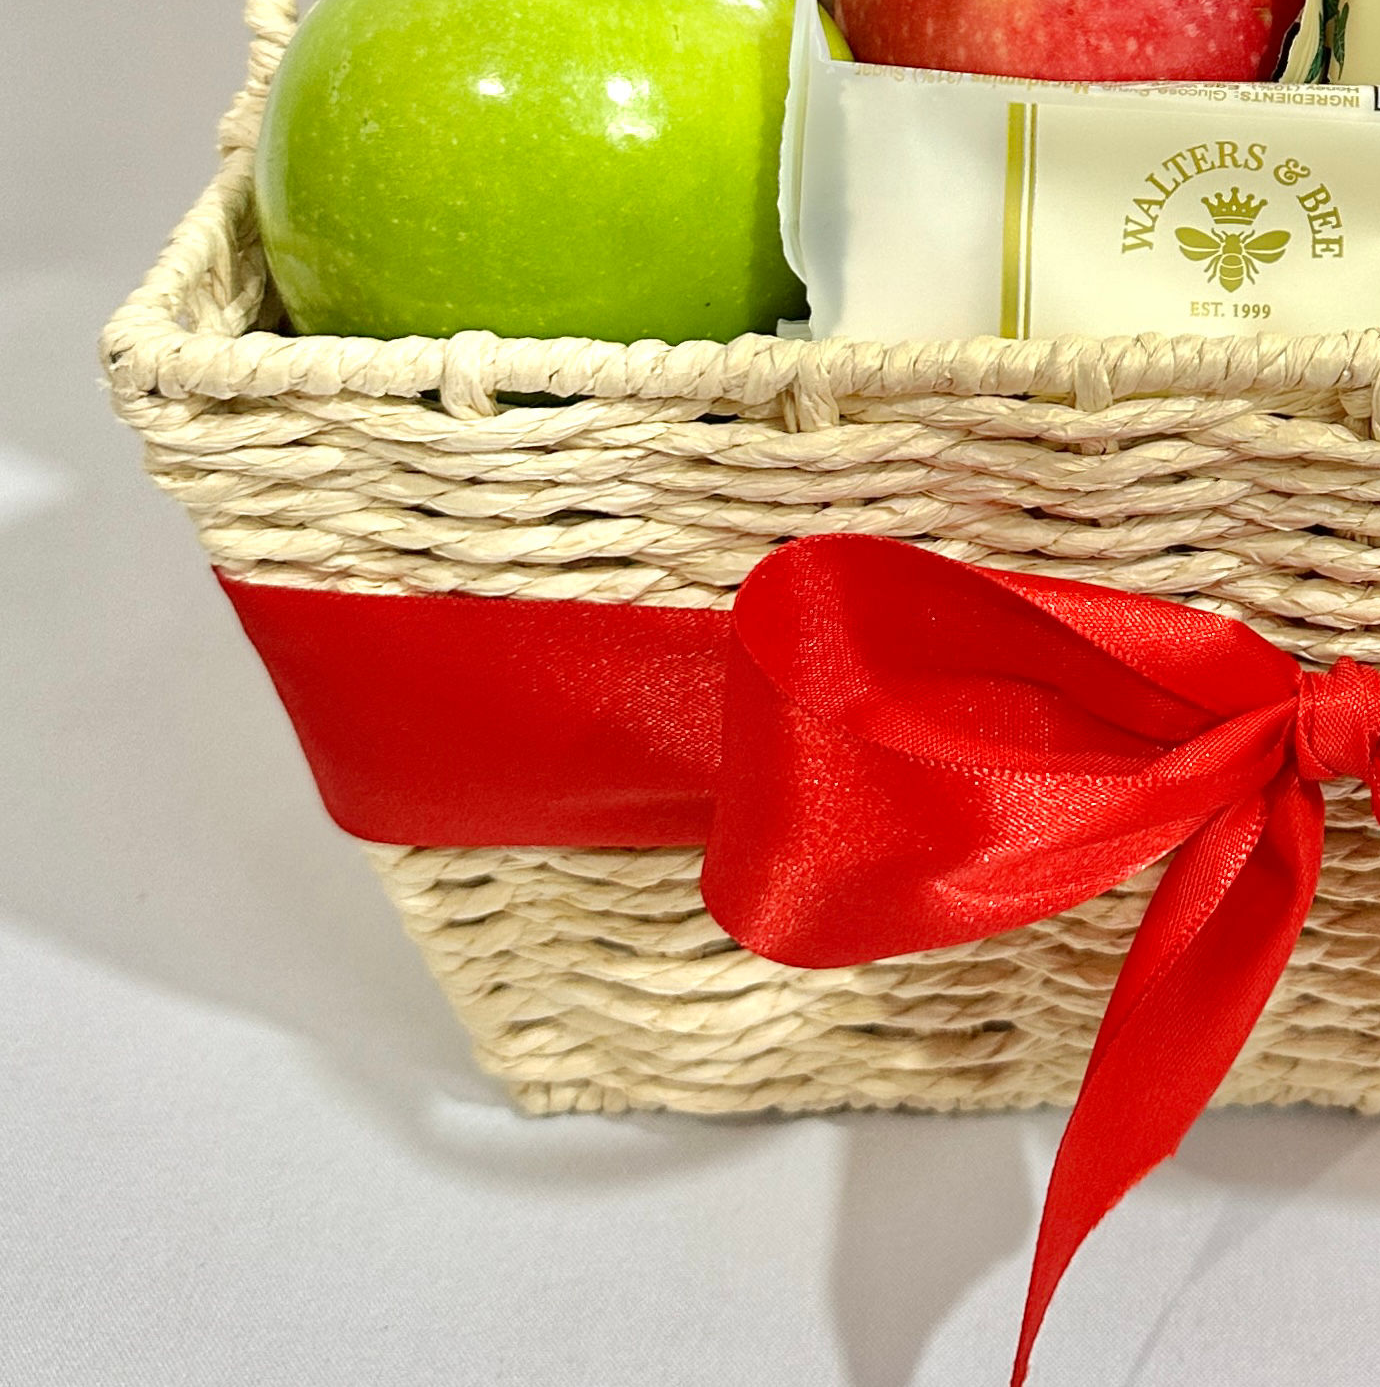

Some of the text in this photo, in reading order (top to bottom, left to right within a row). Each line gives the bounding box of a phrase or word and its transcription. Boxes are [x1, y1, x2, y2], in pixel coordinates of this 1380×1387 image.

[1234, 89, 1361, 108] INGREDIENTS:
[1121, 140, 1344, 258] WALTERS & BEE
[1190, 301, 1272, 319] EST. 1999
